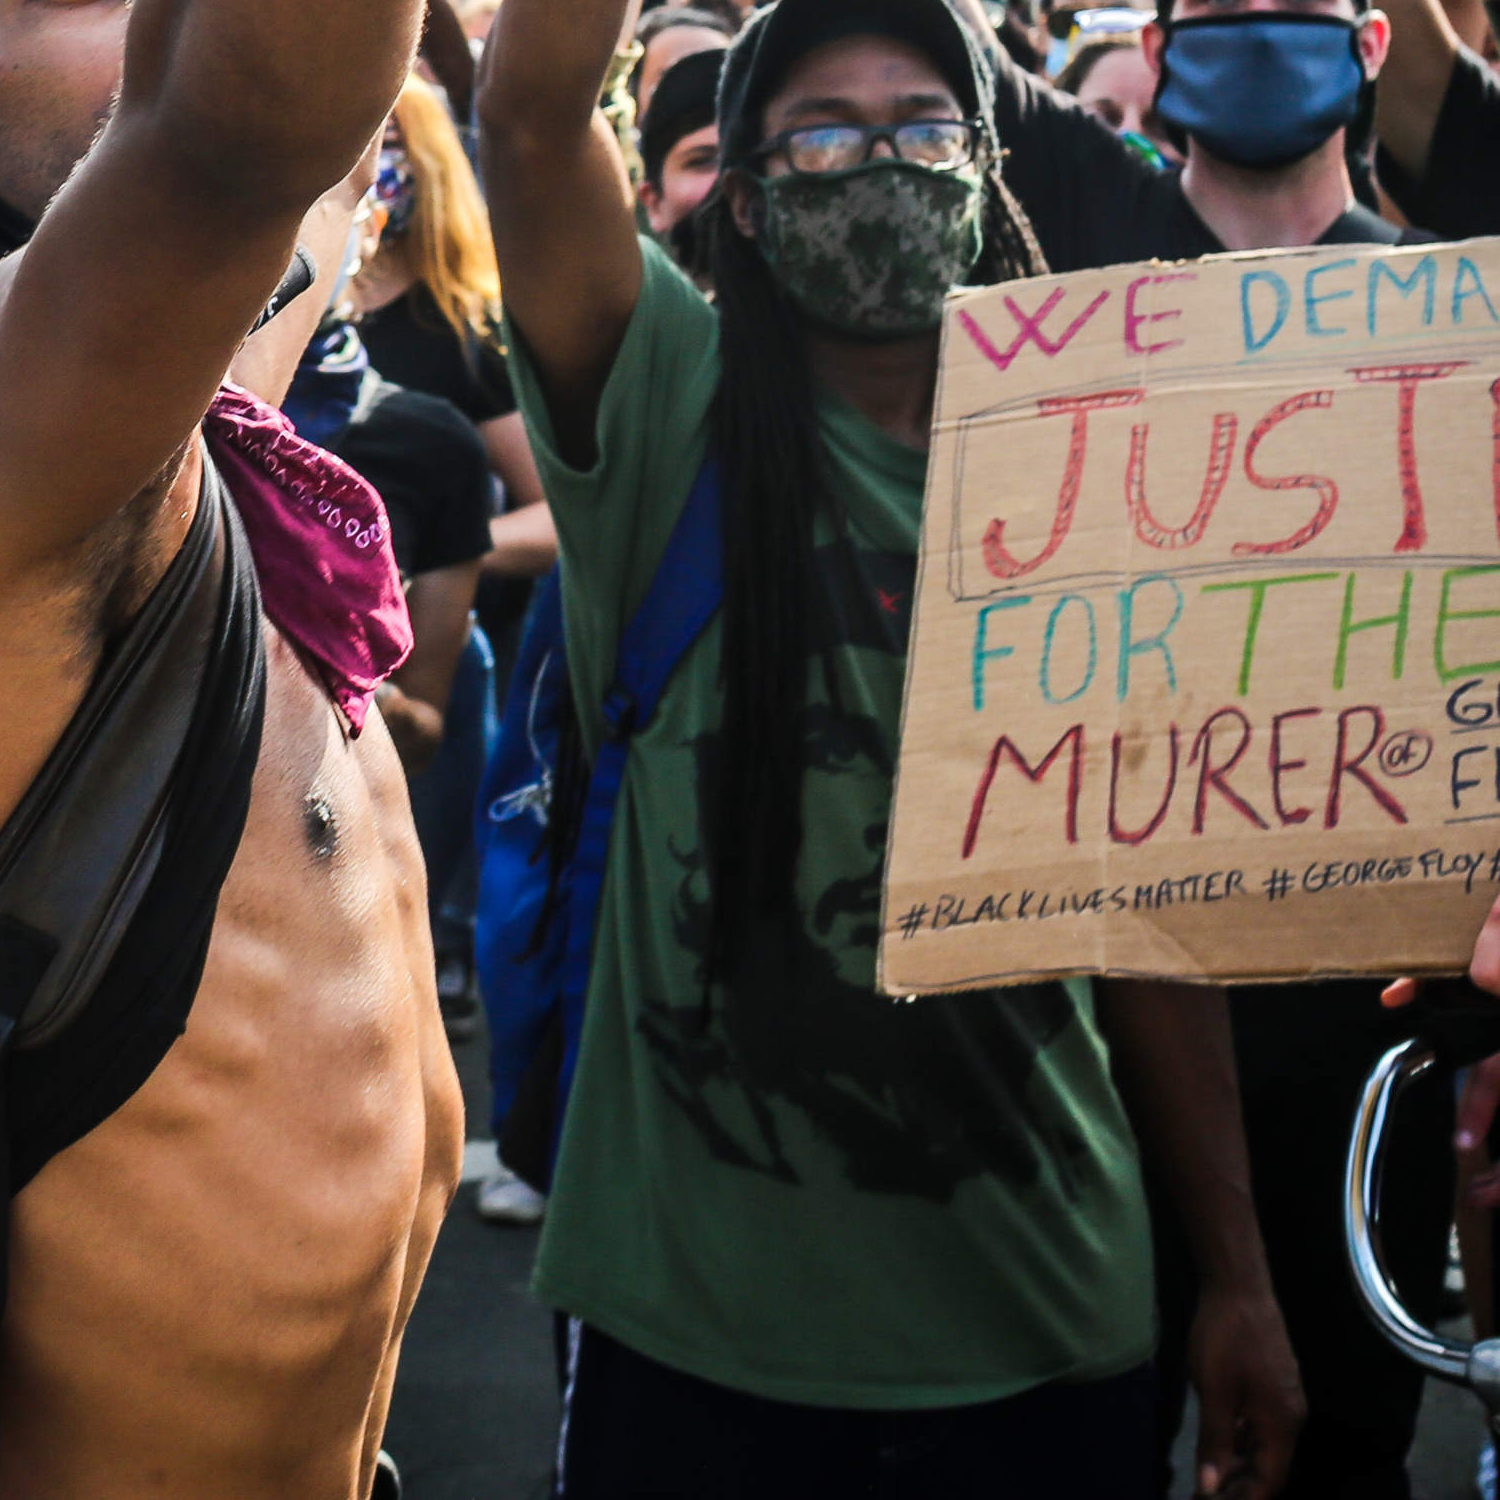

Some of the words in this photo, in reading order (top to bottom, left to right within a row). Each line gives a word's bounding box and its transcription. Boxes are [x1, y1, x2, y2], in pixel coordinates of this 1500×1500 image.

[957, 274, 1196, 371] WE
[1241, 255, 1500, 354] DEMA
[972, 574, 1184, 712] FOR
[1202, 564, 1500, 696] THE
[962, 705, 1408, 860] MURER
